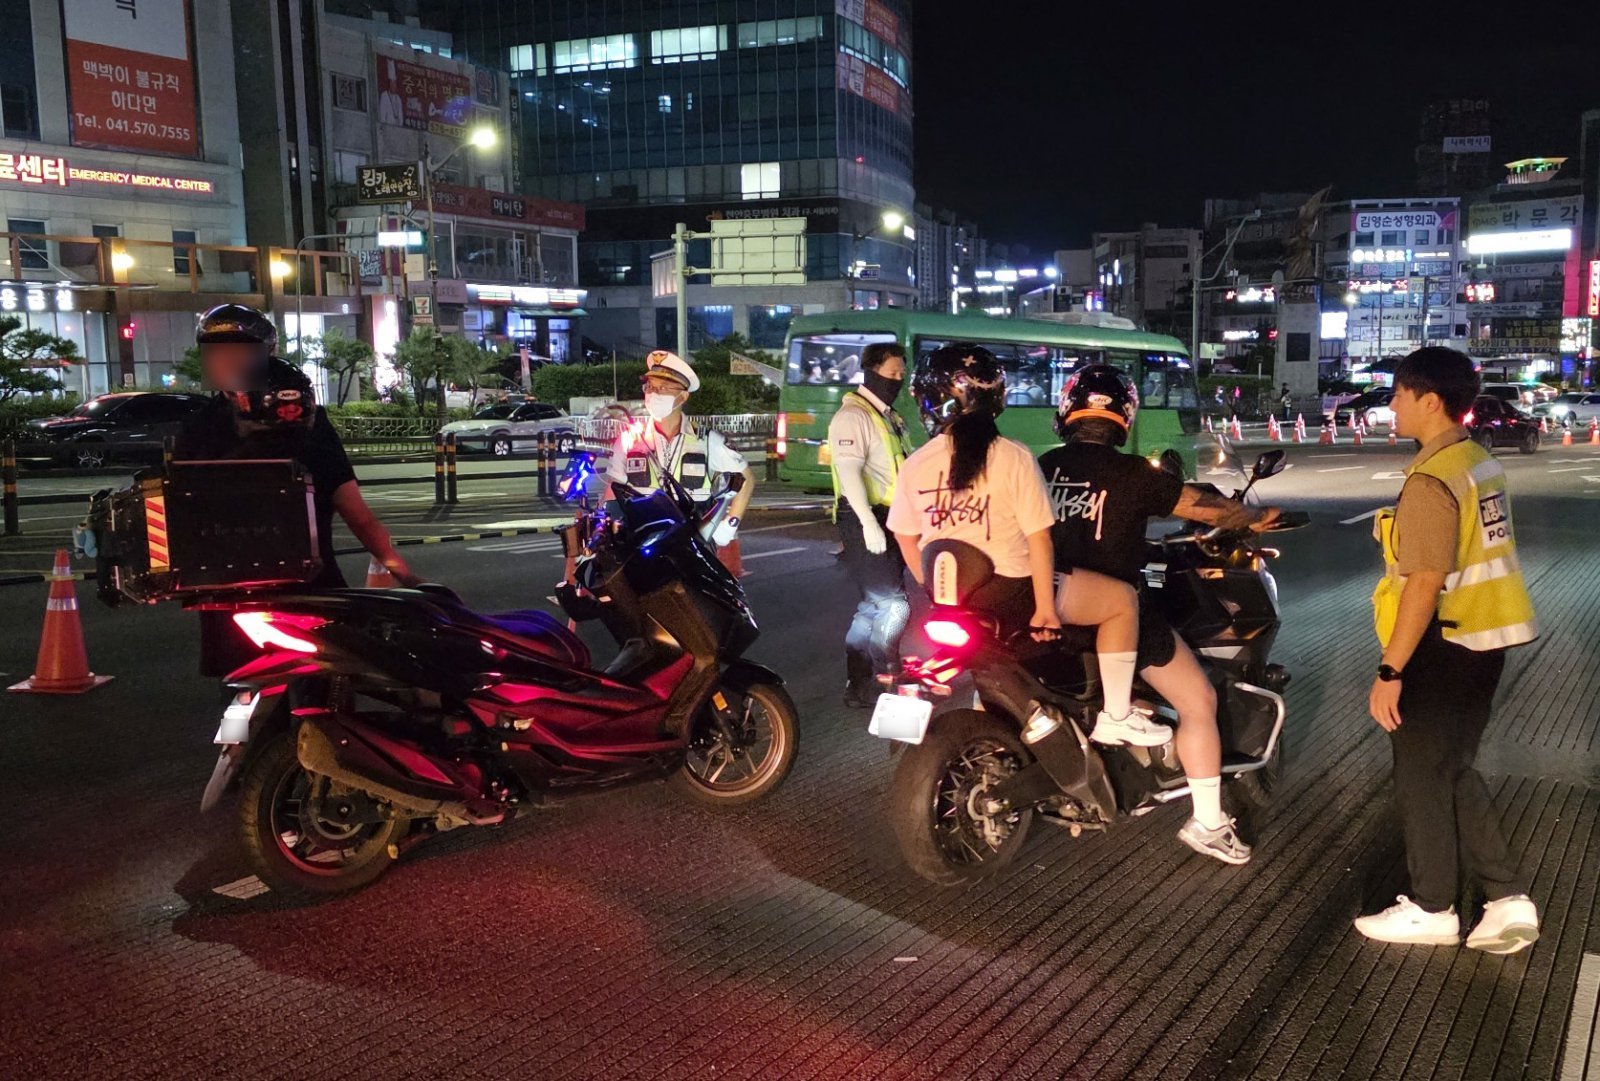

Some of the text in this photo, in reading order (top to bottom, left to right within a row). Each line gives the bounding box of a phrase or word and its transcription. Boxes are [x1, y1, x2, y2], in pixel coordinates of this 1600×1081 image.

[83, 60, 180, 94] 맥박이 불규칙
[111, 90, 157, 115] 하다면
[75, 112, 191, 141] Tel. 041.570.7555
[69, 168, 211, 192] EMERGENCY MEDICAL CENTER
[1360, 214, 1437, 229] 김영순성형외과
